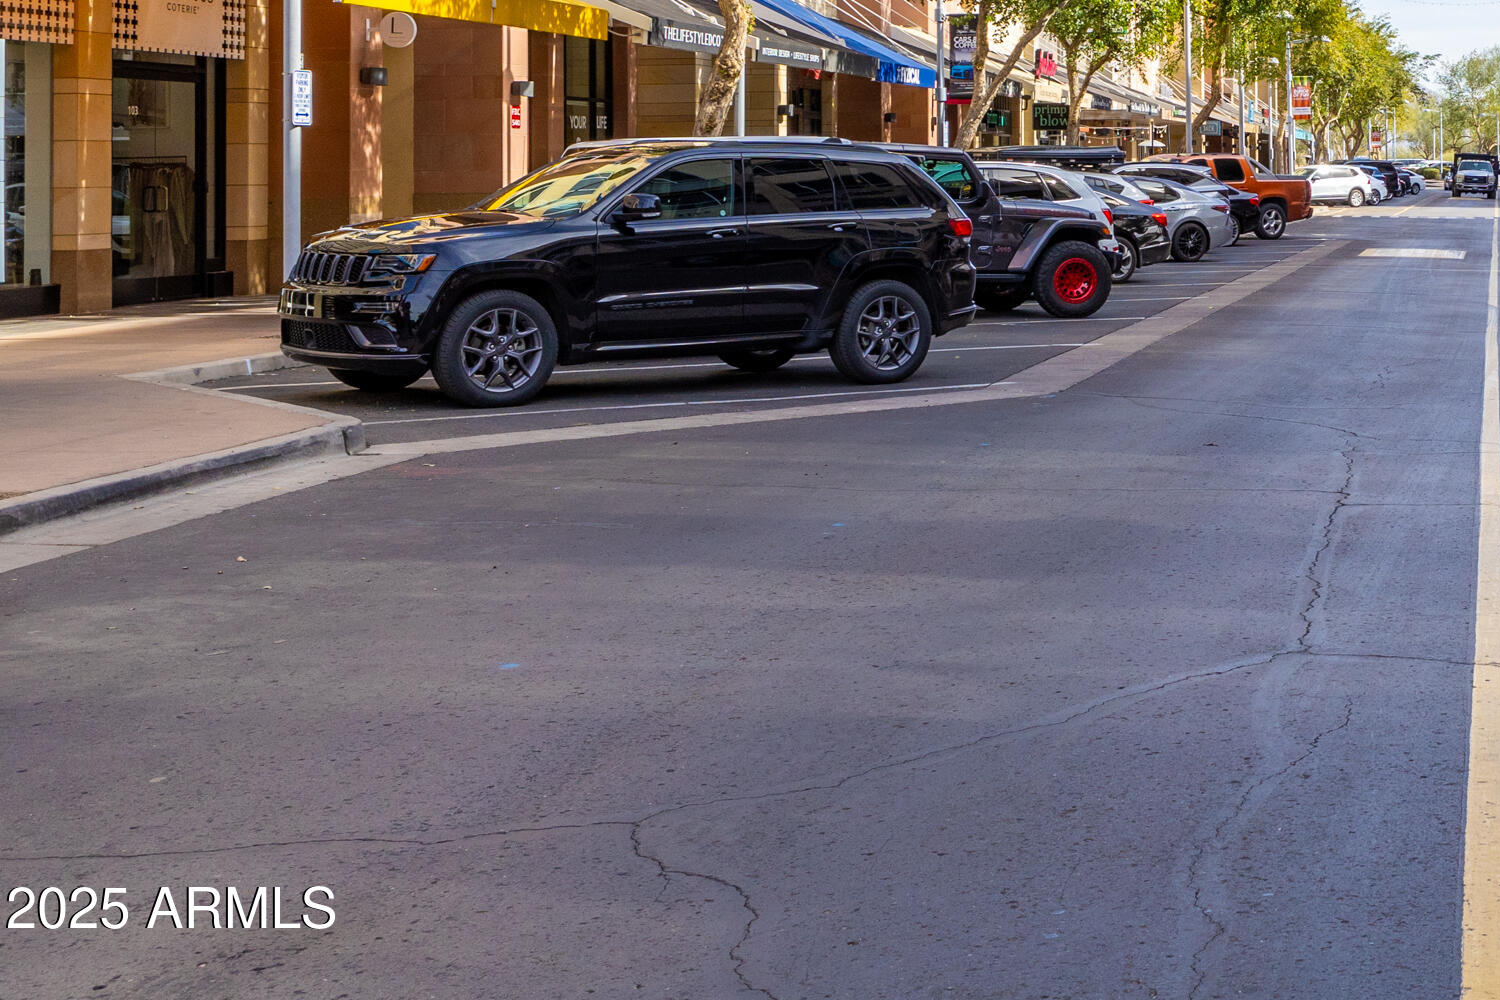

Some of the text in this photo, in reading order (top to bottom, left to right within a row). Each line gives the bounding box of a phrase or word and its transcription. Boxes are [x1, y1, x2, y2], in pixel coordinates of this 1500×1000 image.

[166, 2, 198, 14] COTERIE
[391, 16, 403, 34] L
[778, 49, 790, 58] DESIGN
[128, 105, 139, 115] 103
[1034, 104, 1067, 117] primp
[569, 115, 608, 129] YOUR LIFE
